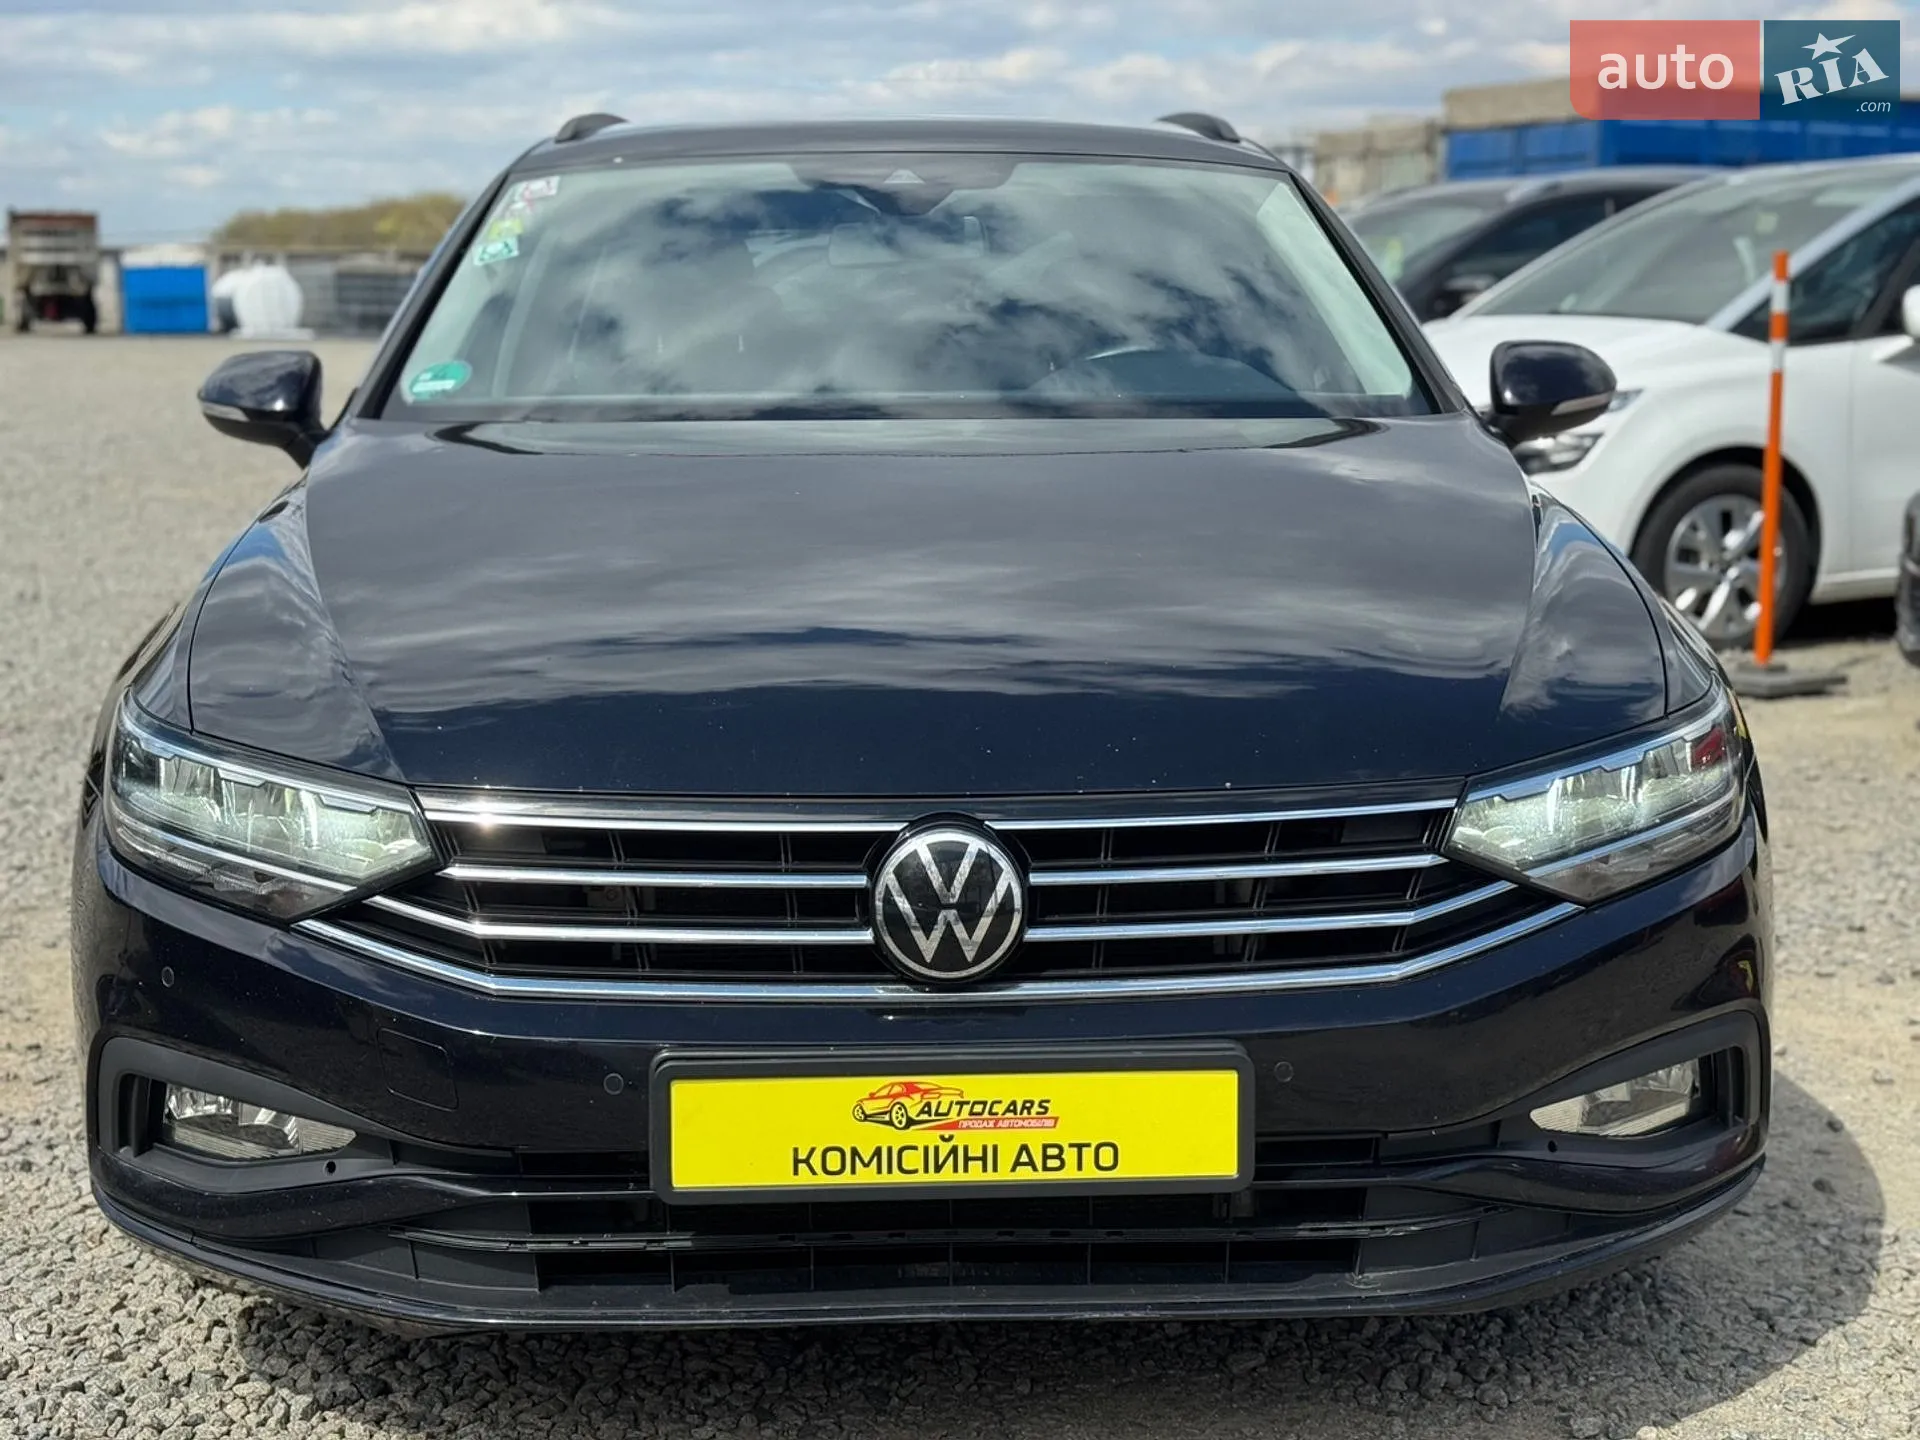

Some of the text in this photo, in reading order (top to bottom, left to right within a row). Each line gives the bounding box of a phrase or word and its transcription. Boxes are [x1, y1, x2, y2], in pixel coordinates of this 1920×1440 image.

[916, 1099, 1051, 1118] AUTOCARS
[792, 1134, 1119, 1176] КОМІСІЙНІ АВТО
